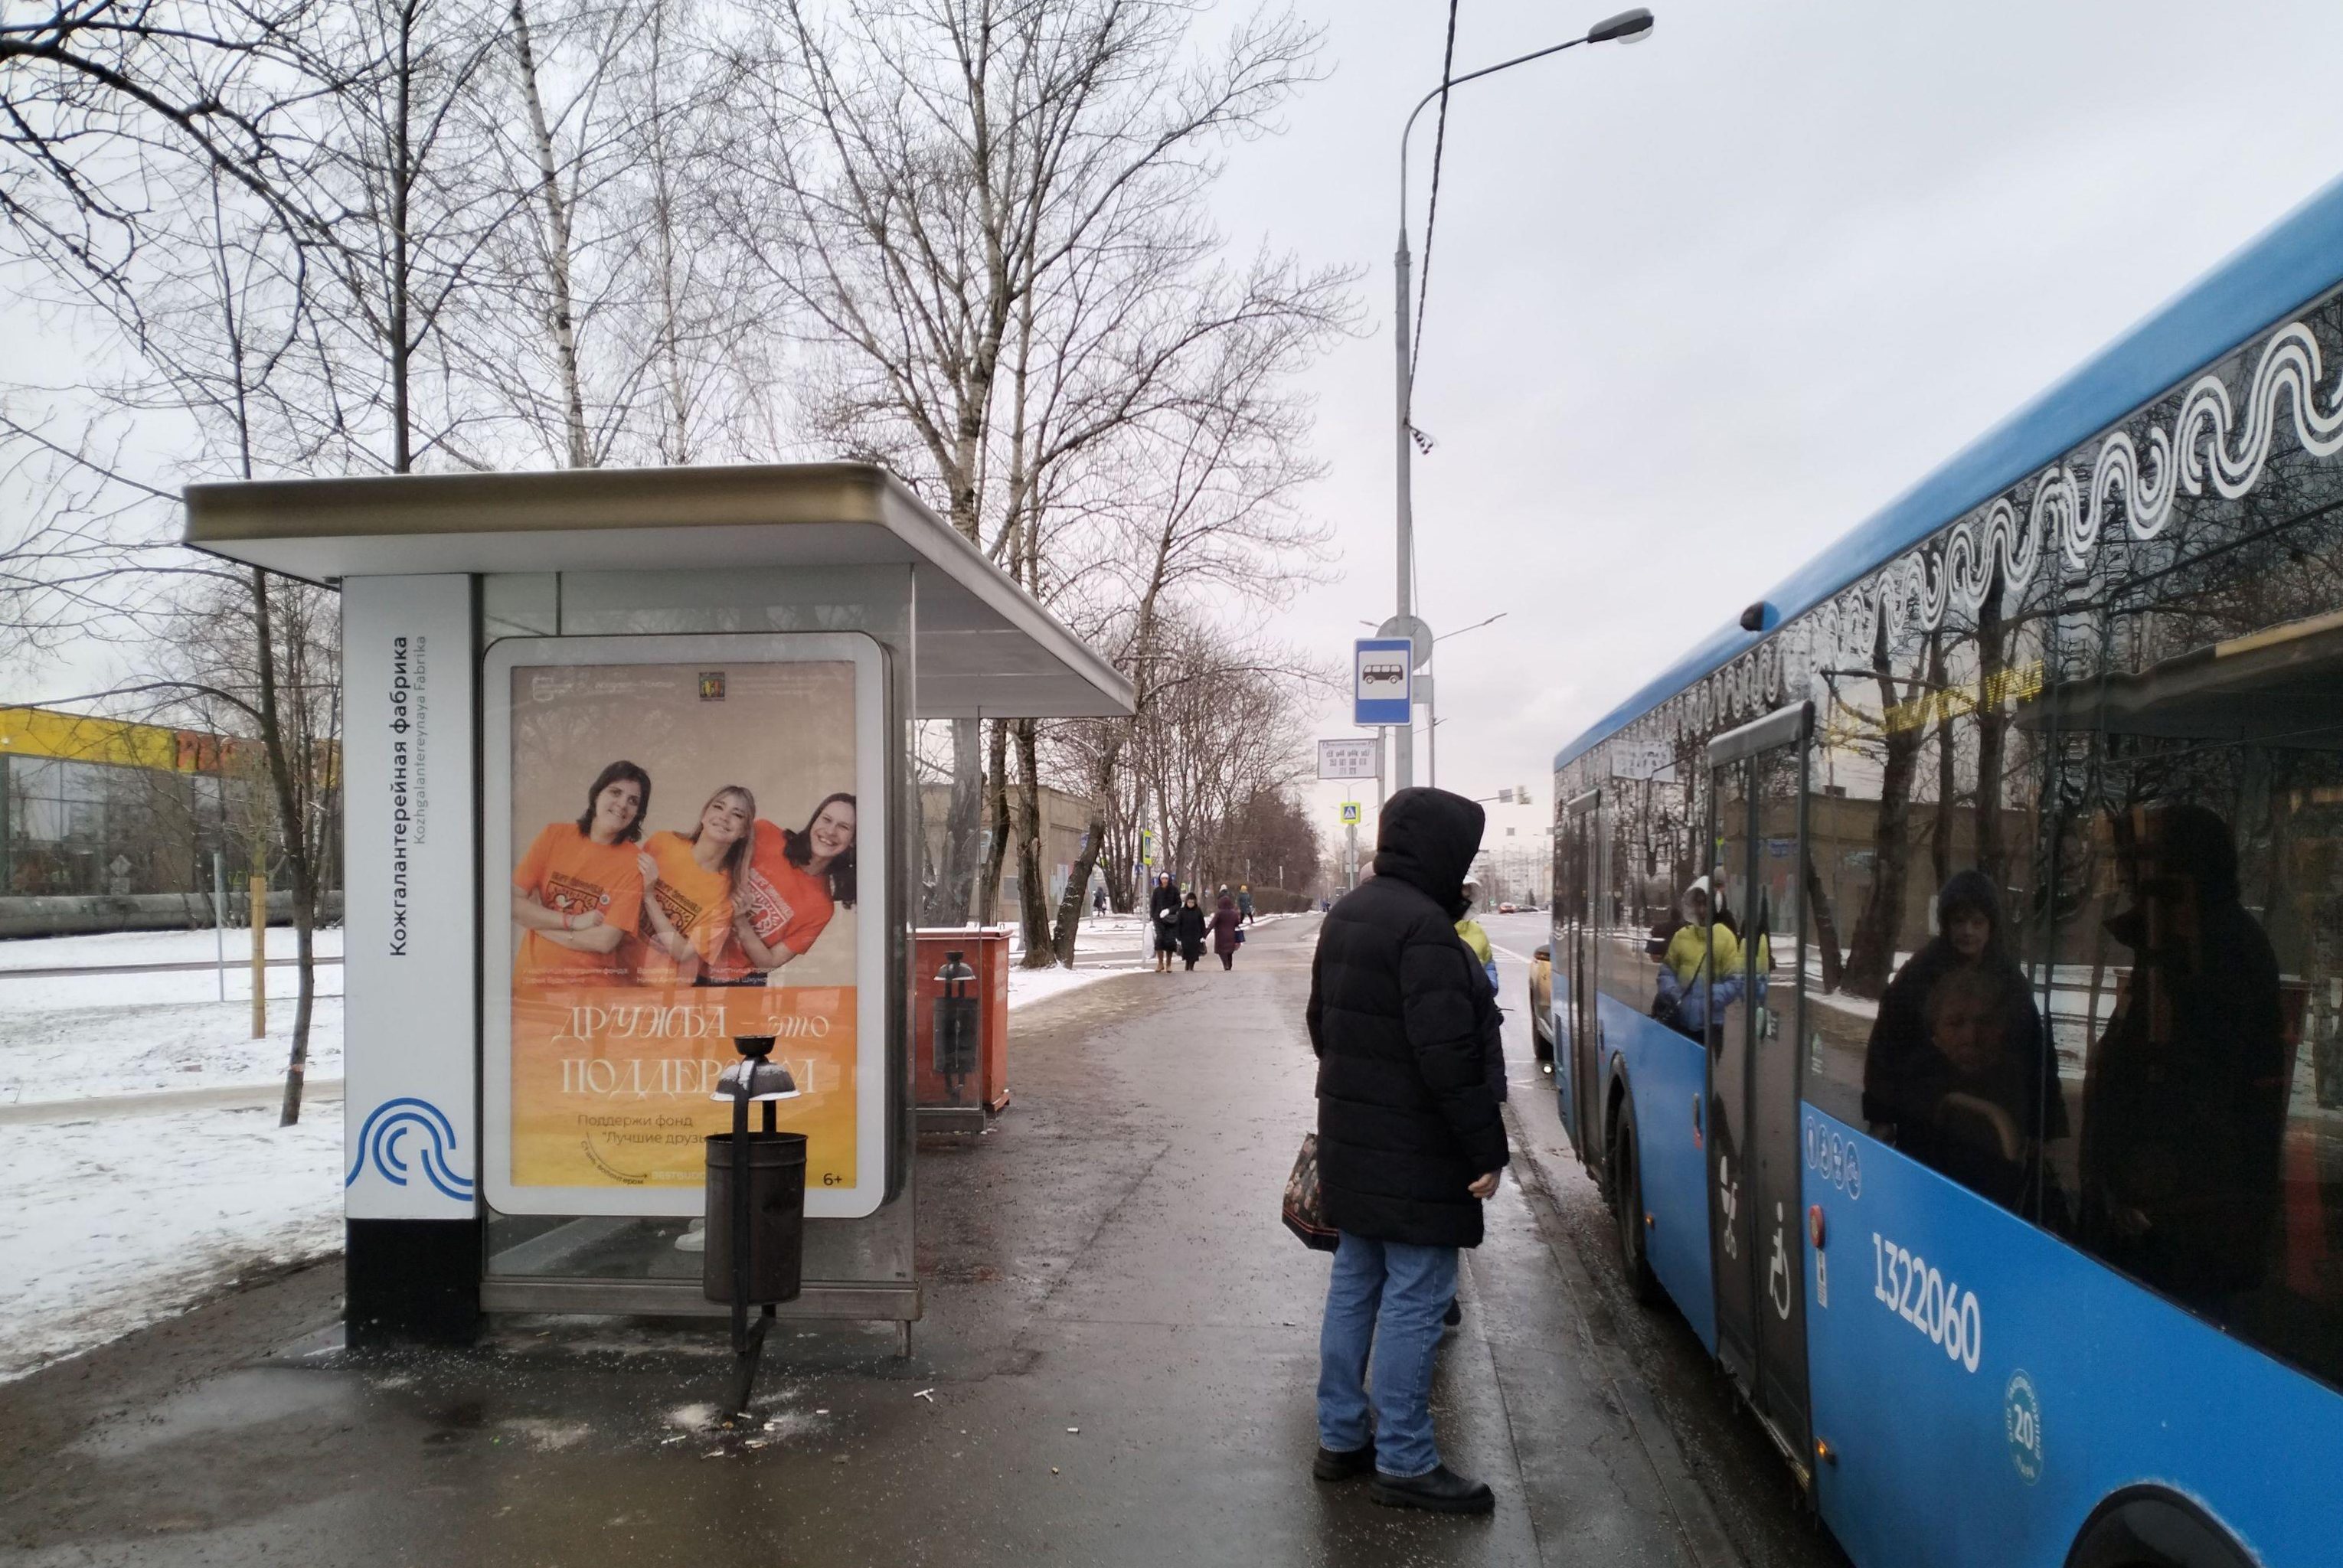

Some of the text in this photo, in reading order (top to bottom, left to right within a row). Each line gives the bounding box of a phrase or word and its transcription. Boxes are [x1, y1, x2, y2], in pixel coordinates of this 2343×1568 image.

[413, 635, 429, 844] Kozhgalantereynaya Fabrika
[389, 635, 410, 956] Кожгалантерейная фабрика
[551, 1005, 728, 1045] ДРУЖБА
[766, 1013, 830, 1038] это
[560, 1058, 817, 1101] ПОДДЕРА
[577, 1114, 694, 1128] Поддержи фонд
[823, 1173, 843, 1186] 6+
[1872, 1231, 1982, 1374] 1322060
[2014, 1403, 2034, 1450] 20
